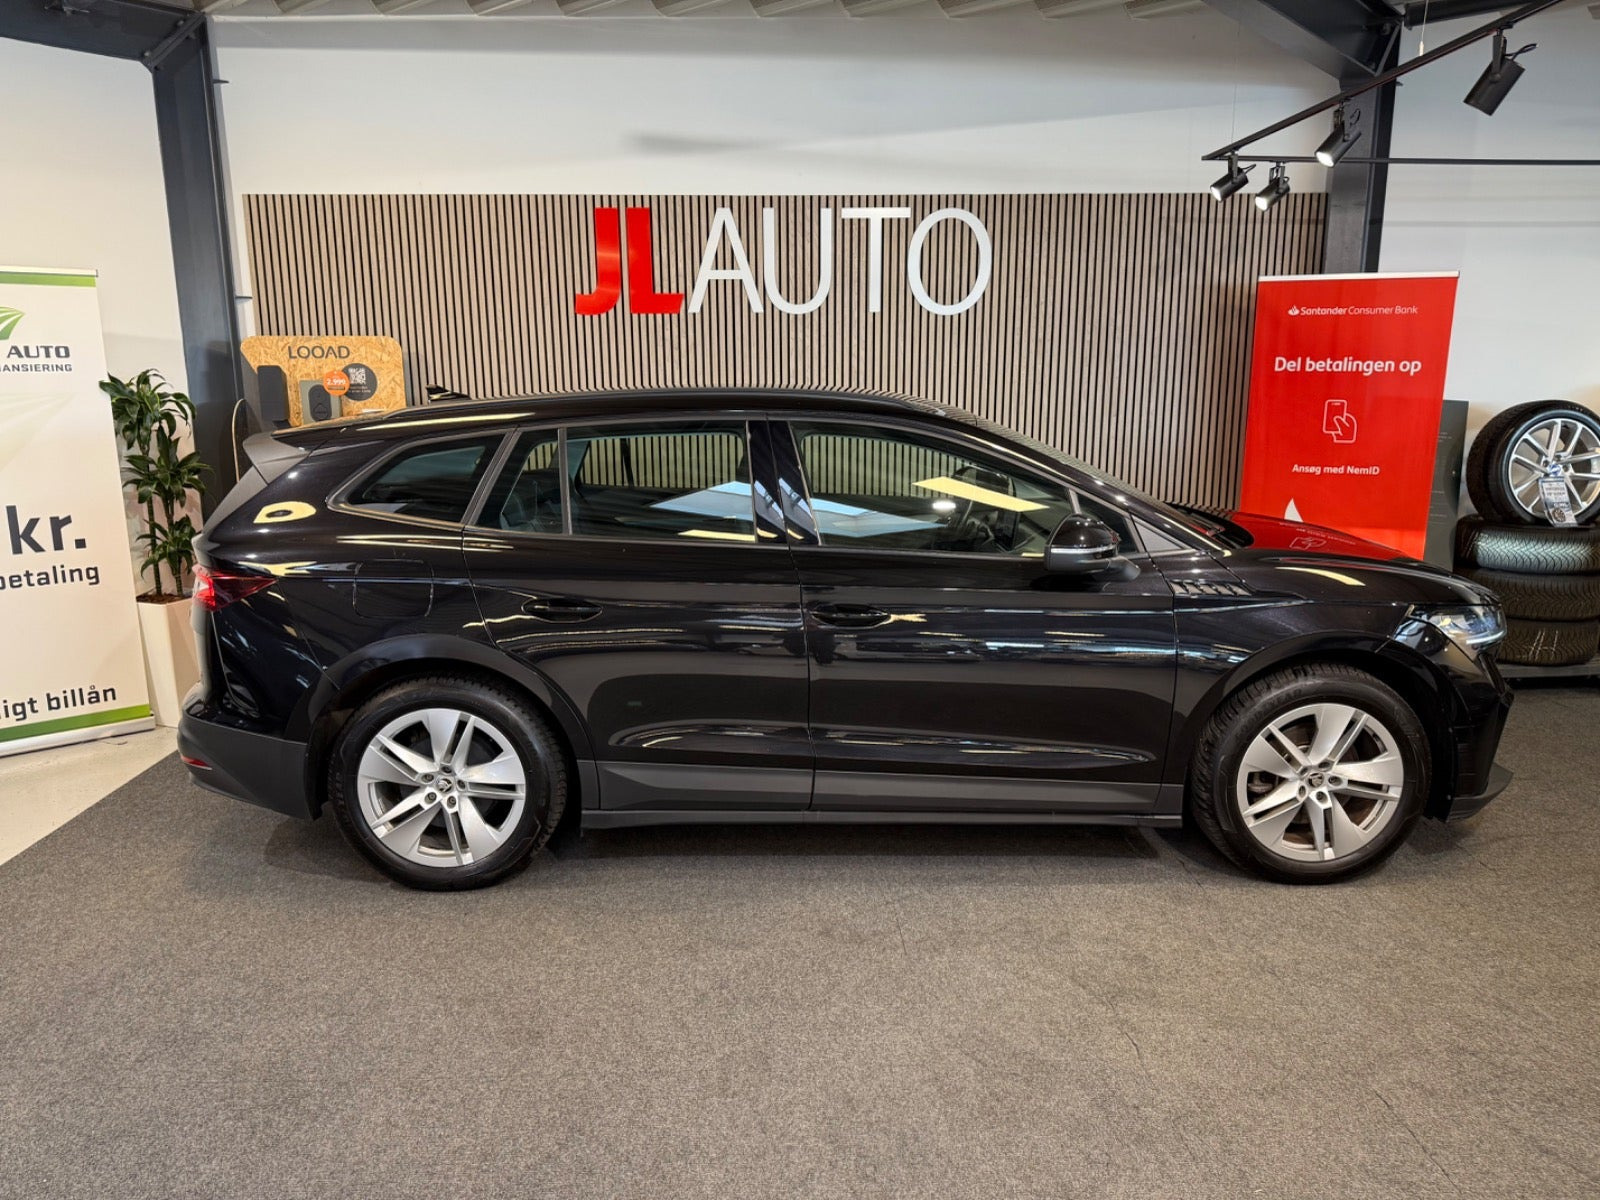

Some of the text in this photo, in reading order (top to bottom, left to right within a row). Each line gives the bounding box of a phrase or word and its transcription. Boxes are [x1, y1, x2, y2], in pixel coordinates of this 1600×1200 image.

[575, 207, 992, 316] JL AUTO
[1300, 305, 1418, 315] Santander Consumer Bank
[7, 345, 70, 358] AUTO
[288, 345, 350, 359] LOOAD
[1274, 356, 1422, 376] Del betalingen op
[1292, 464, 1380, 475] Ansøg med NemID
[6, 505, 87, 555] kr.
[0, 685, 116, 721] igt billån
